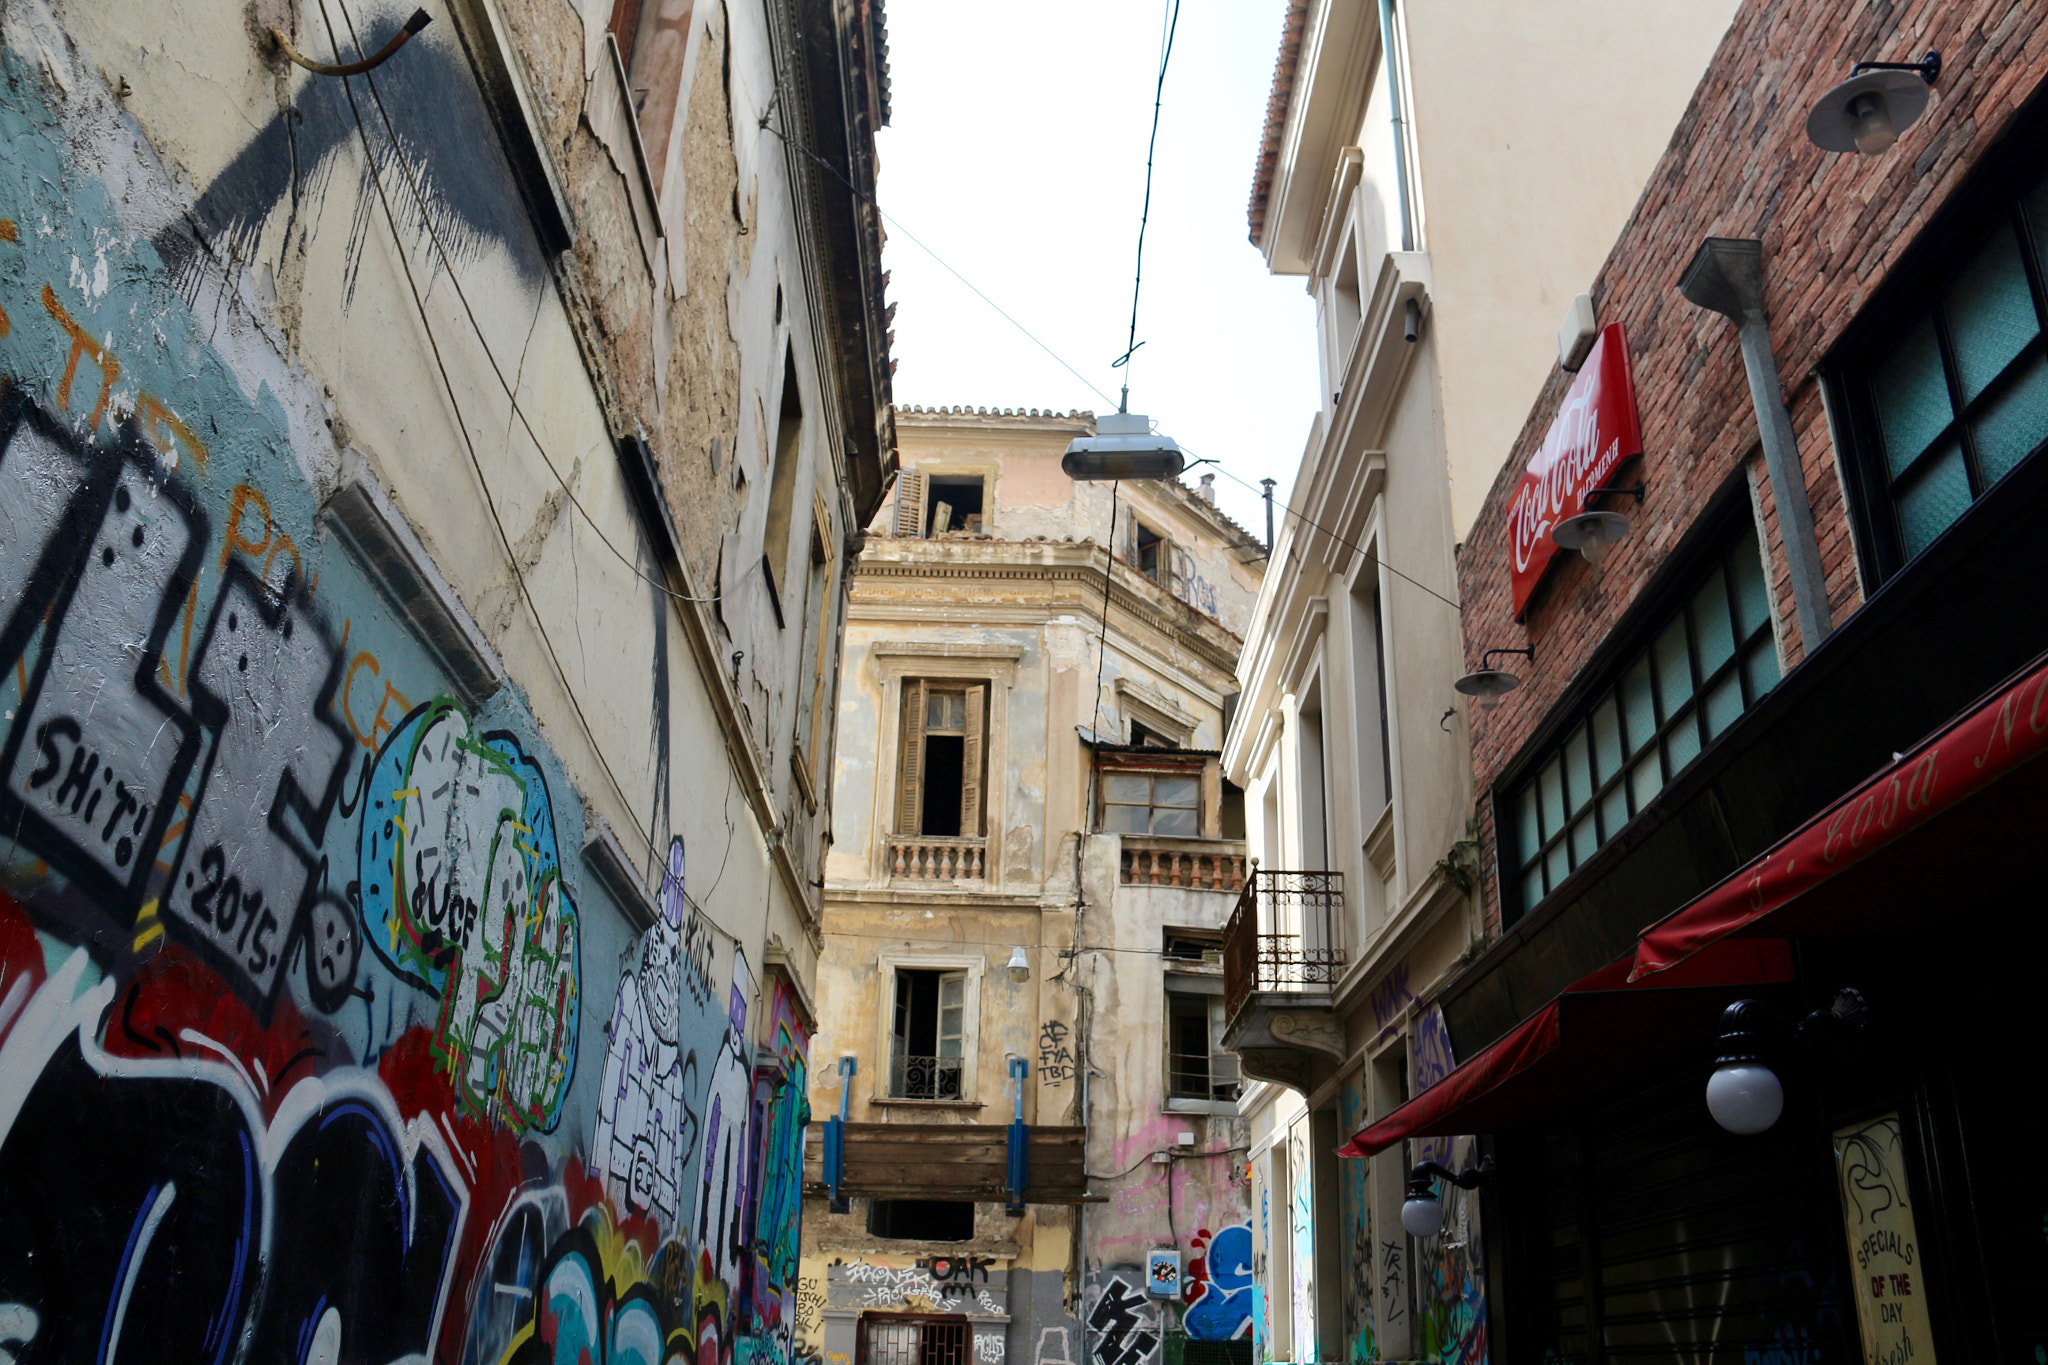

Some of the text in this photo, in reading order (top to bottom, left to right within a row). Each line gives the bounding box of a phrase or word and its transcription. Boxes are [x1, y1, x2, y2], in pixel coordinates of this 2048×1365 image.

[1858, 1229, 1914, 1269] SPECIALS
[1871, 1272, 1911, 1298] OF THE
[1881, 1302, 1903, 1323] DAY
